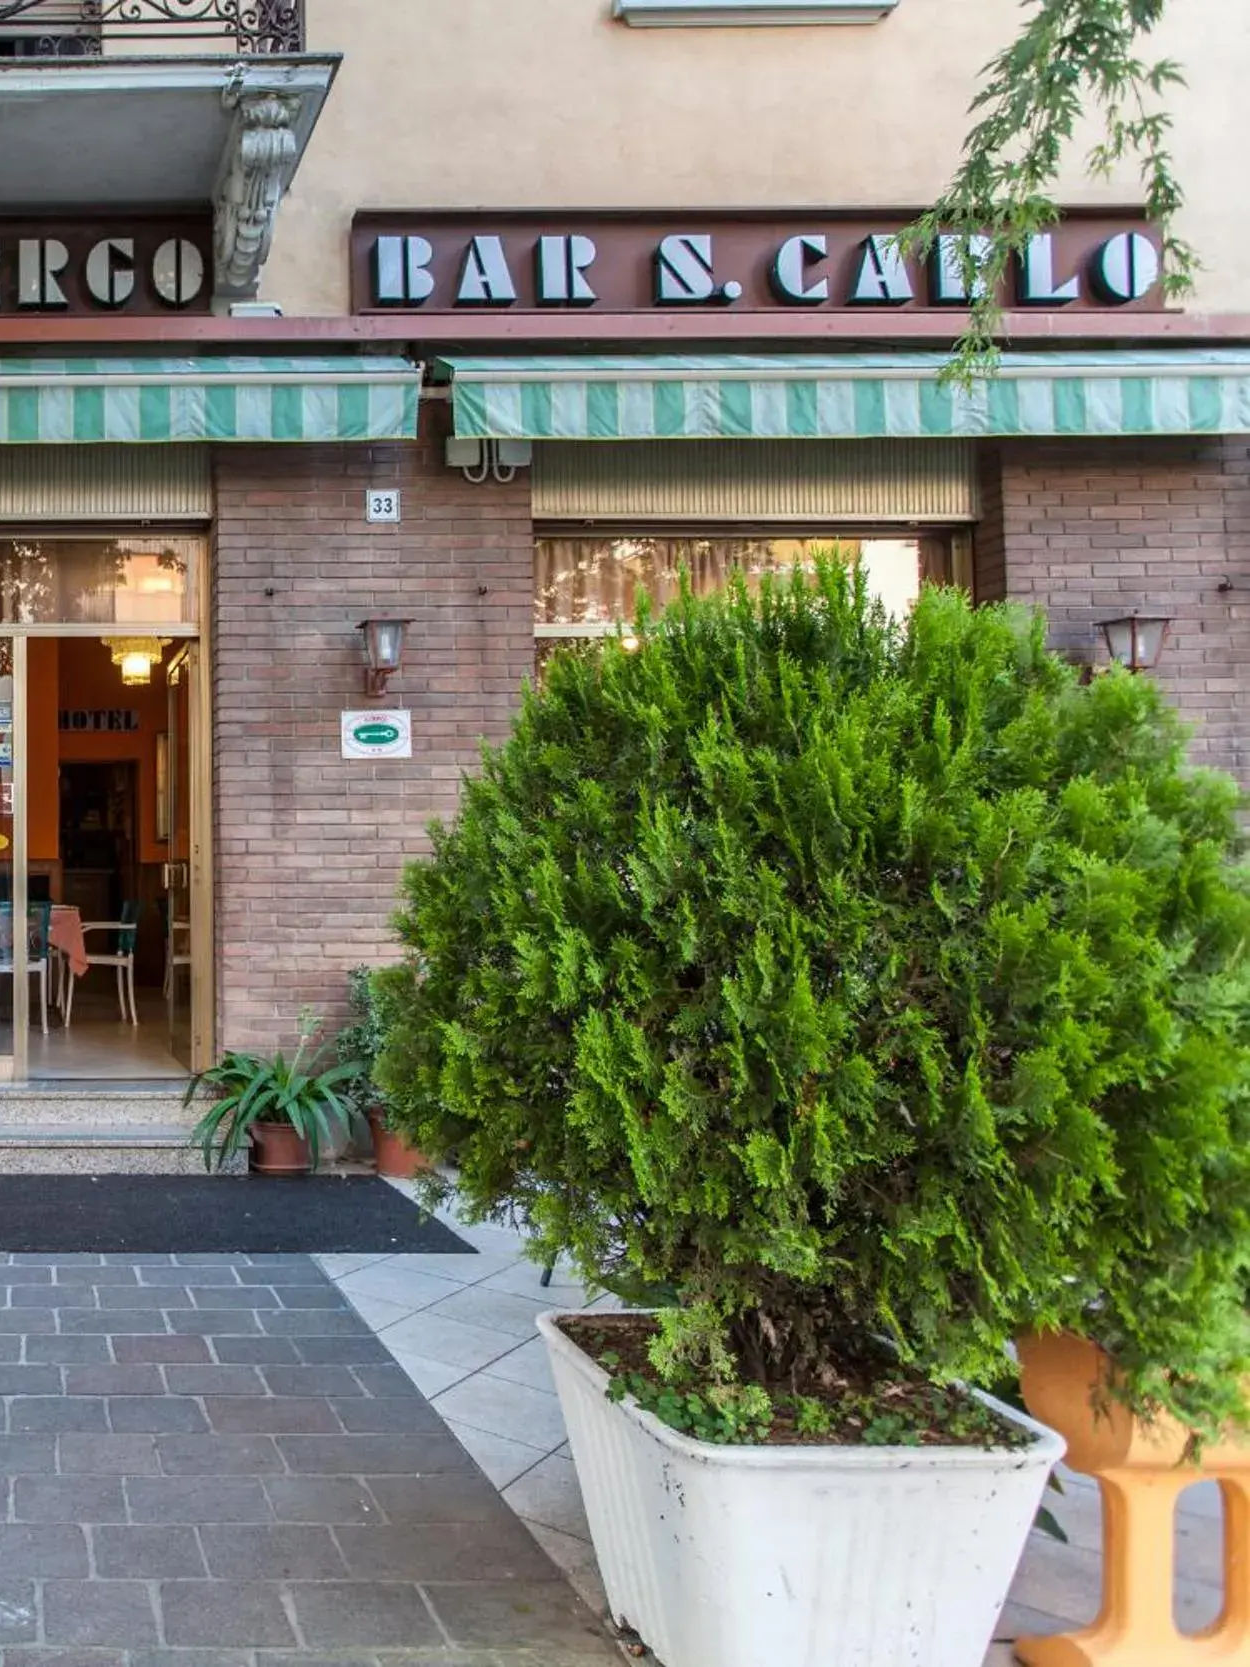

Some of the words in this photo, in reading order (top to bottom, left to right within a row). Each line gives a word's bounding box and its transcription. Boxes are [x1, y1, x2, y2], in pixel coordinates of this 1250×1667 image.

[374, 234, 597, 304] BAR
[653, 234, 743, 304] S.
[772, 231, 1159, 306] CARLO
[372, 497, 393, 514] 33
